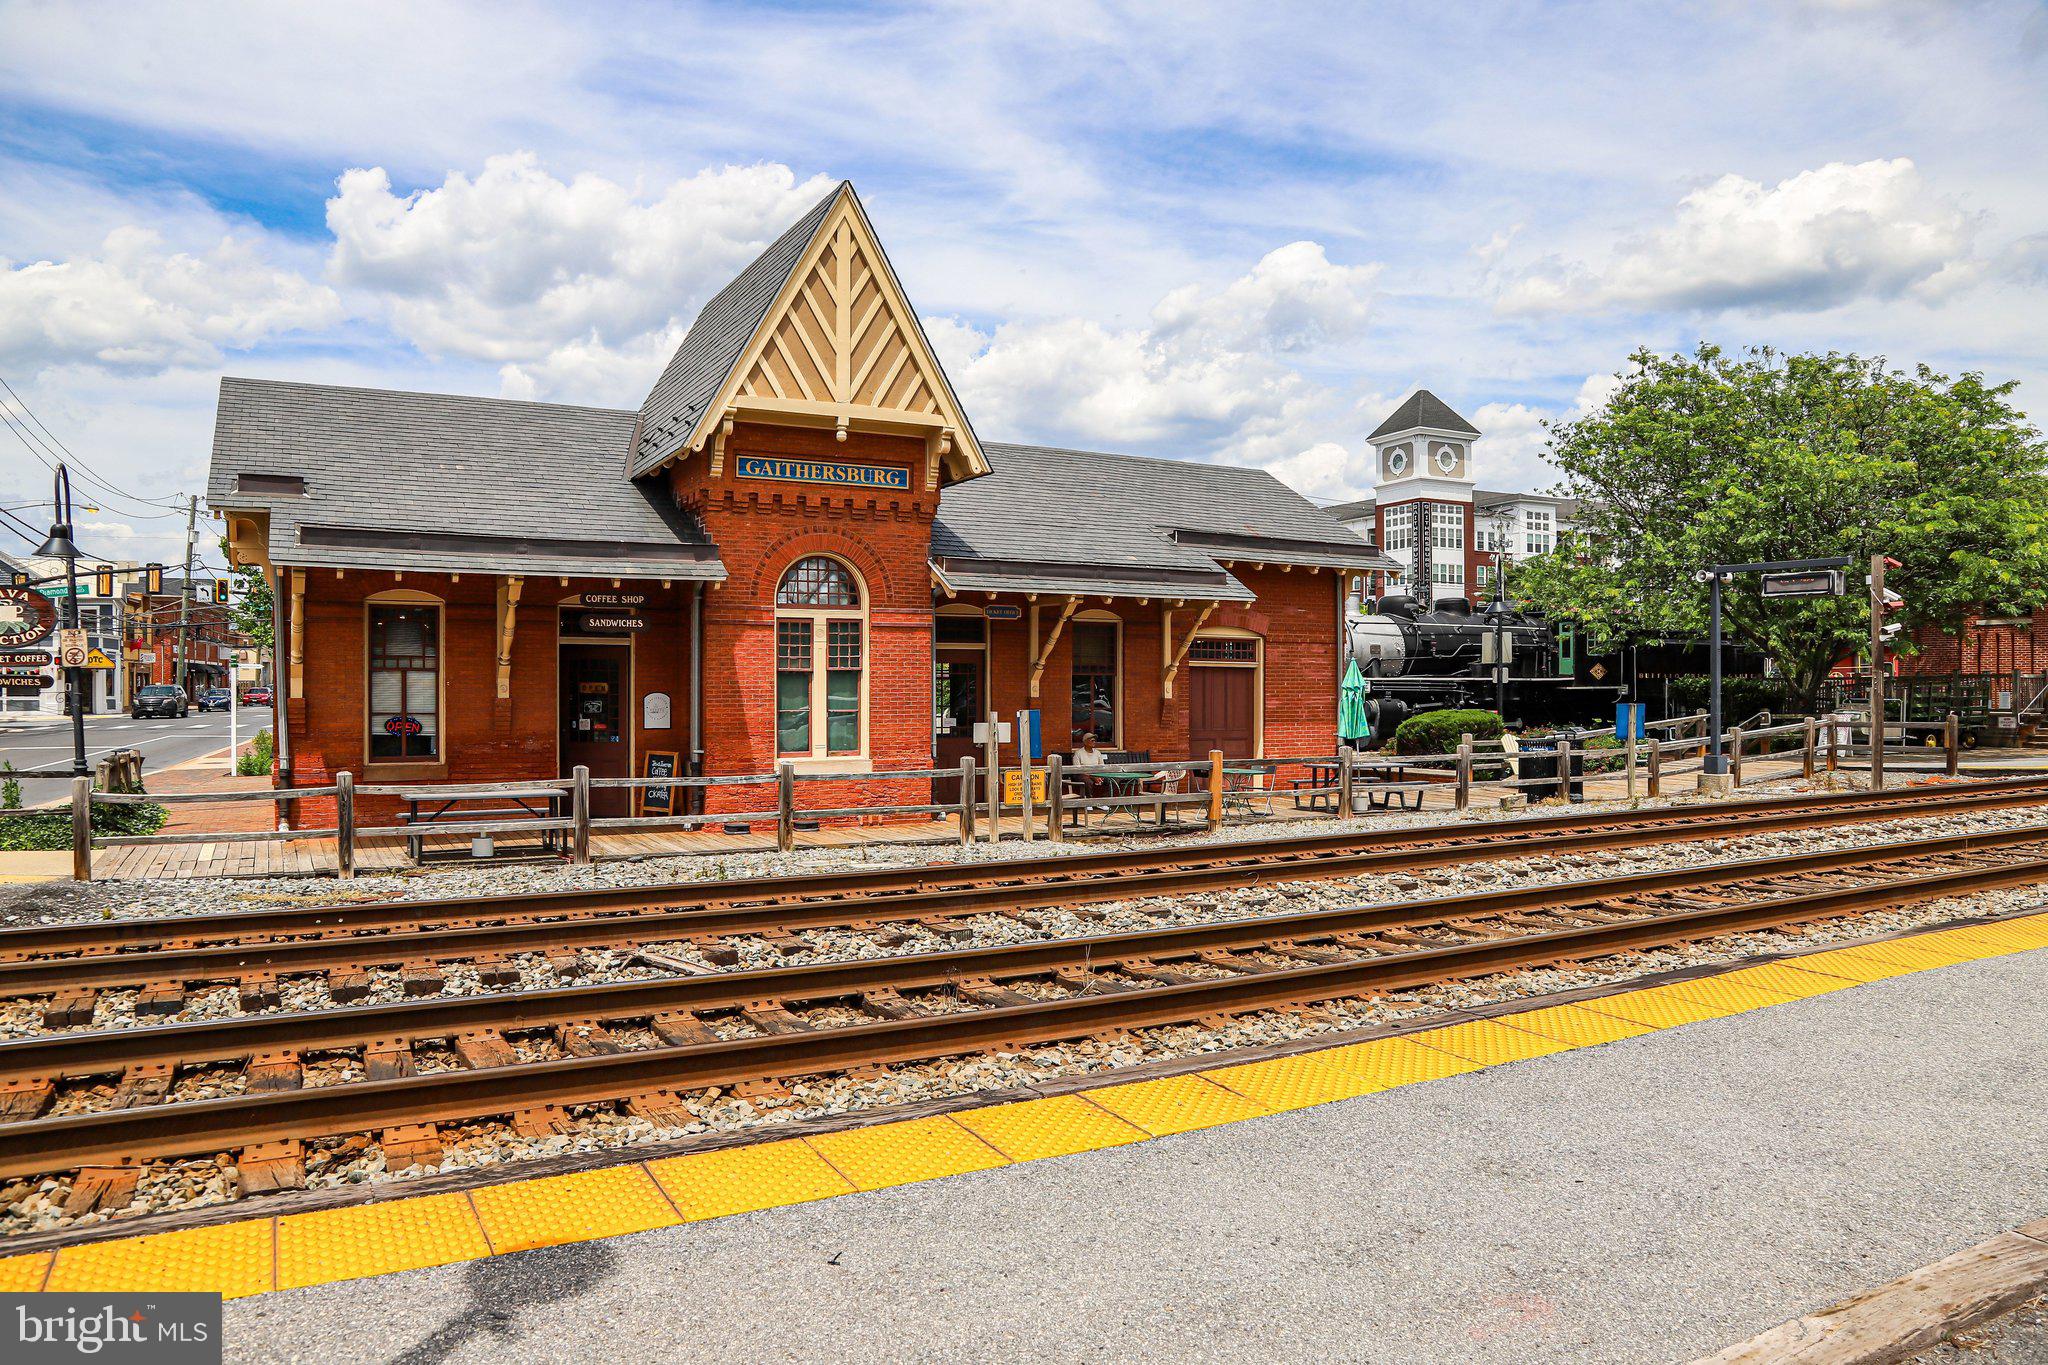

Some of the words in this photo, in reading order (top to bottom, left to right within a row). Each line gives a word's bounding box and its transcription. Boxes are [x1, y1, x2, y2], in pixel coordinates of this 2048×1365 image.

[745, 460, 900, 485] GAITHERSBURG
[585, 594, 618, 604] COFFEE
[621, 595, 645, 604] SHOP
[589, 618, 644, 628] SANDWICHES
[14, 655, 48, 663] COFFEE
[386, 721, 420, 733] OPEN
[1011, 773, 1040, 781] CAON
